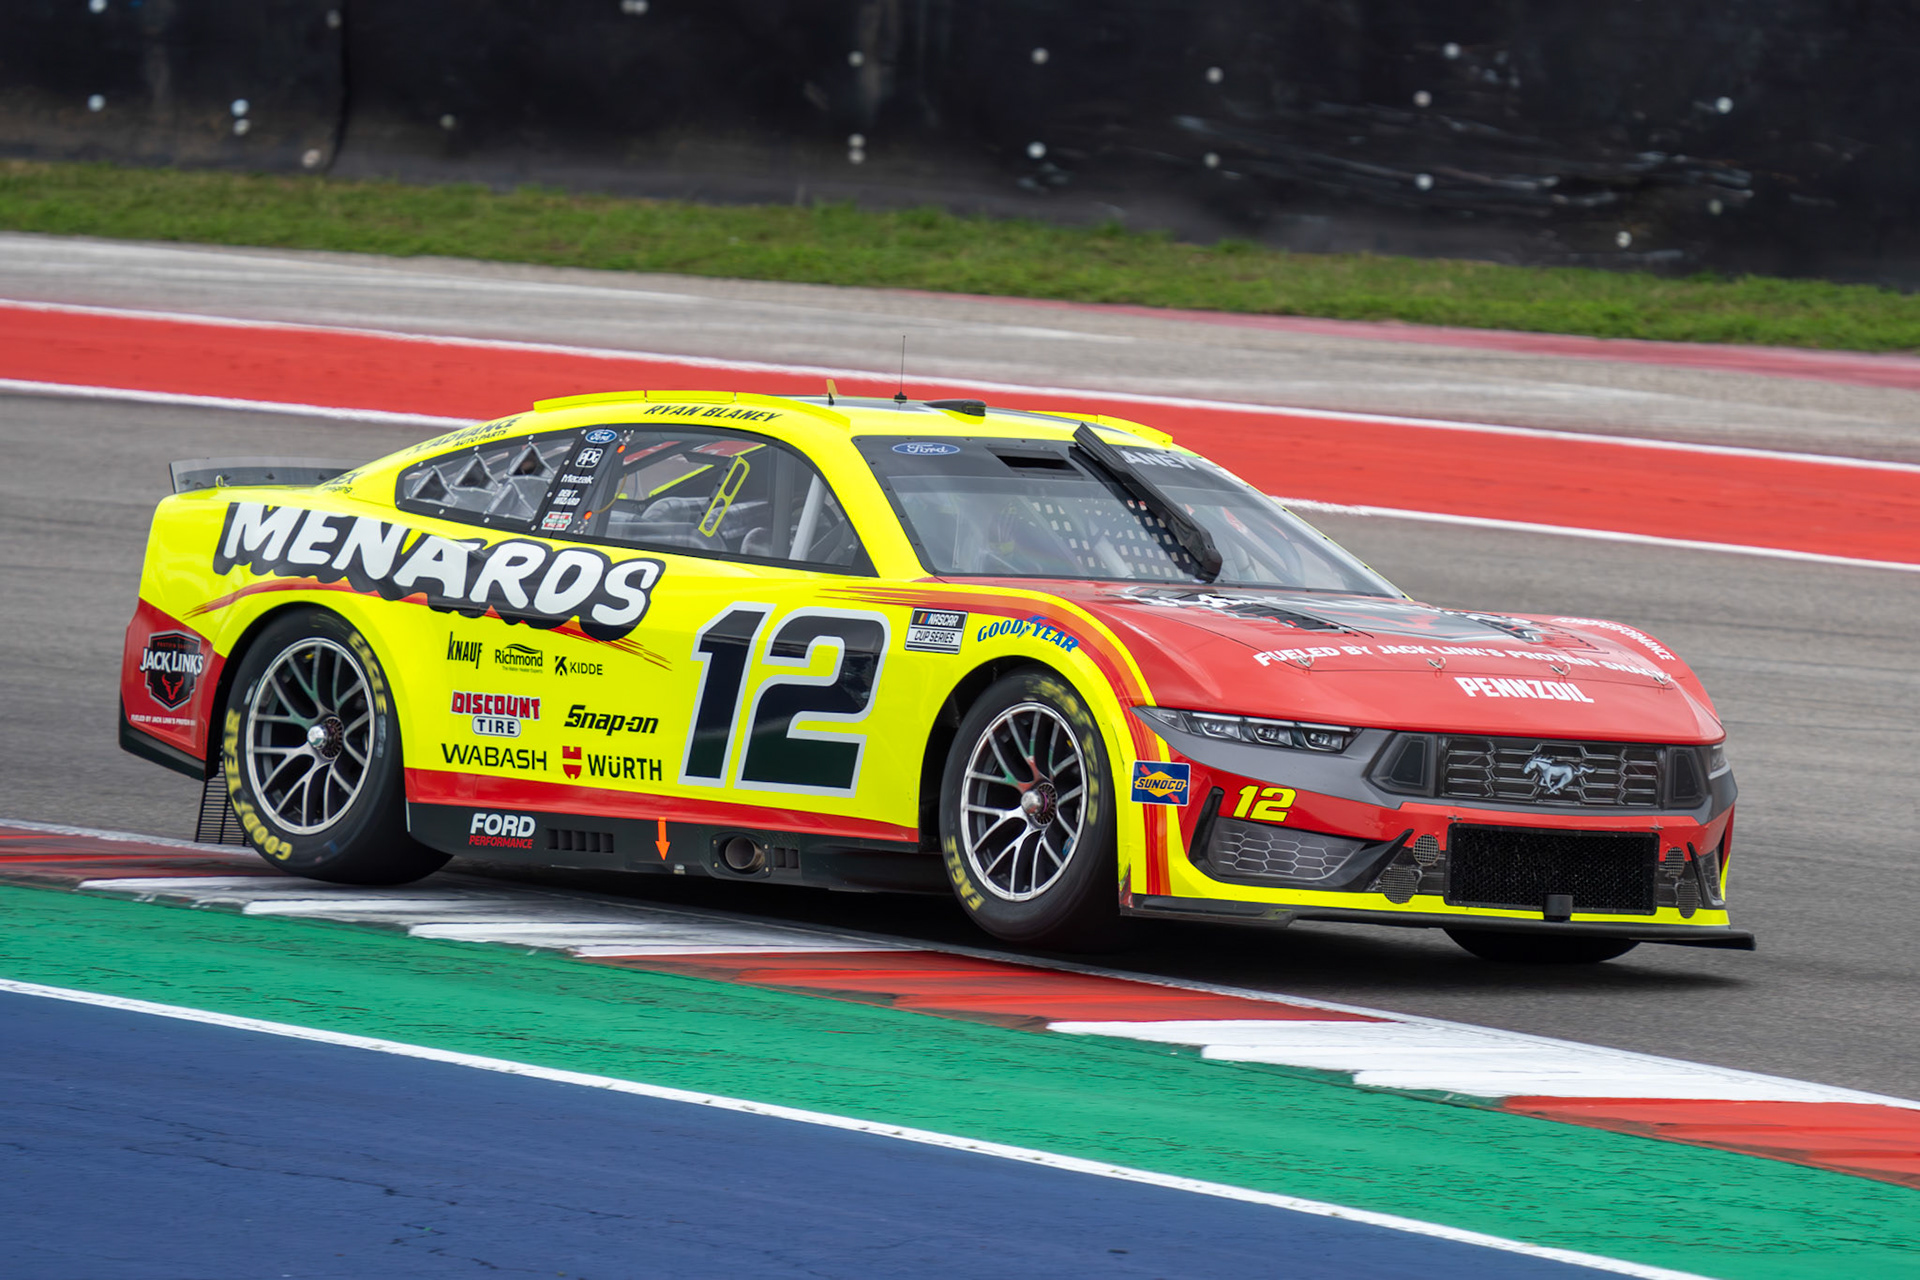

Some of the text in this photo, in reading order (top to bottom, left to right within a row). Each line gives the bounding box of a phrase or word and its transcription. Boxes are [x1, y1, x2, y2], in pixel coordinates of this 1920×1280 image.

[644, 405, 783, 422] RYAN BLANEY
[426, 416, 521, 449] ADVANCE
[907, 444, 948, 453] Ford
[1120, 450, 1196, 470] ANEY
[218, 501, 664, 632] MENARDS
[928, 613, 959, 626] NASCAR
[915, 630, 955, 643] CUP SERIES
[977, 617, 1079, 653] GOODYEAR
[140, 647, 171, 673] JACK
[495, 649, 543, 667] Richmond
[570, 662, 603, 675] KIDDE
[1253, 646, 1341, 667] FUELED
[1341, 646, 1374, 655] BY
[1377, 645, 1434, 655] JACK
[1432, 646, 1506, 657] LINK'S
[678, 601, 891, 798] 12
[1454, 677, 1594, 703] PENNZOIL
[451, 691, 540, 719] DISCOUNT
[478, 719, 515, 734] TIRE
[564, 704, 659, 736] Snap-on
[441, 743, 547, 771] WABASH
[588, 754, 663, 781] WÜRTH
[223, 708, 293, 861] GOODYEAR
[1137, 778, 1184, 791] SUNOCO
[1233, 785, 1296, 822] 12
[470, 813, 536, 837] FORD
[469, 835, 533, 849] PERFORMANCE
